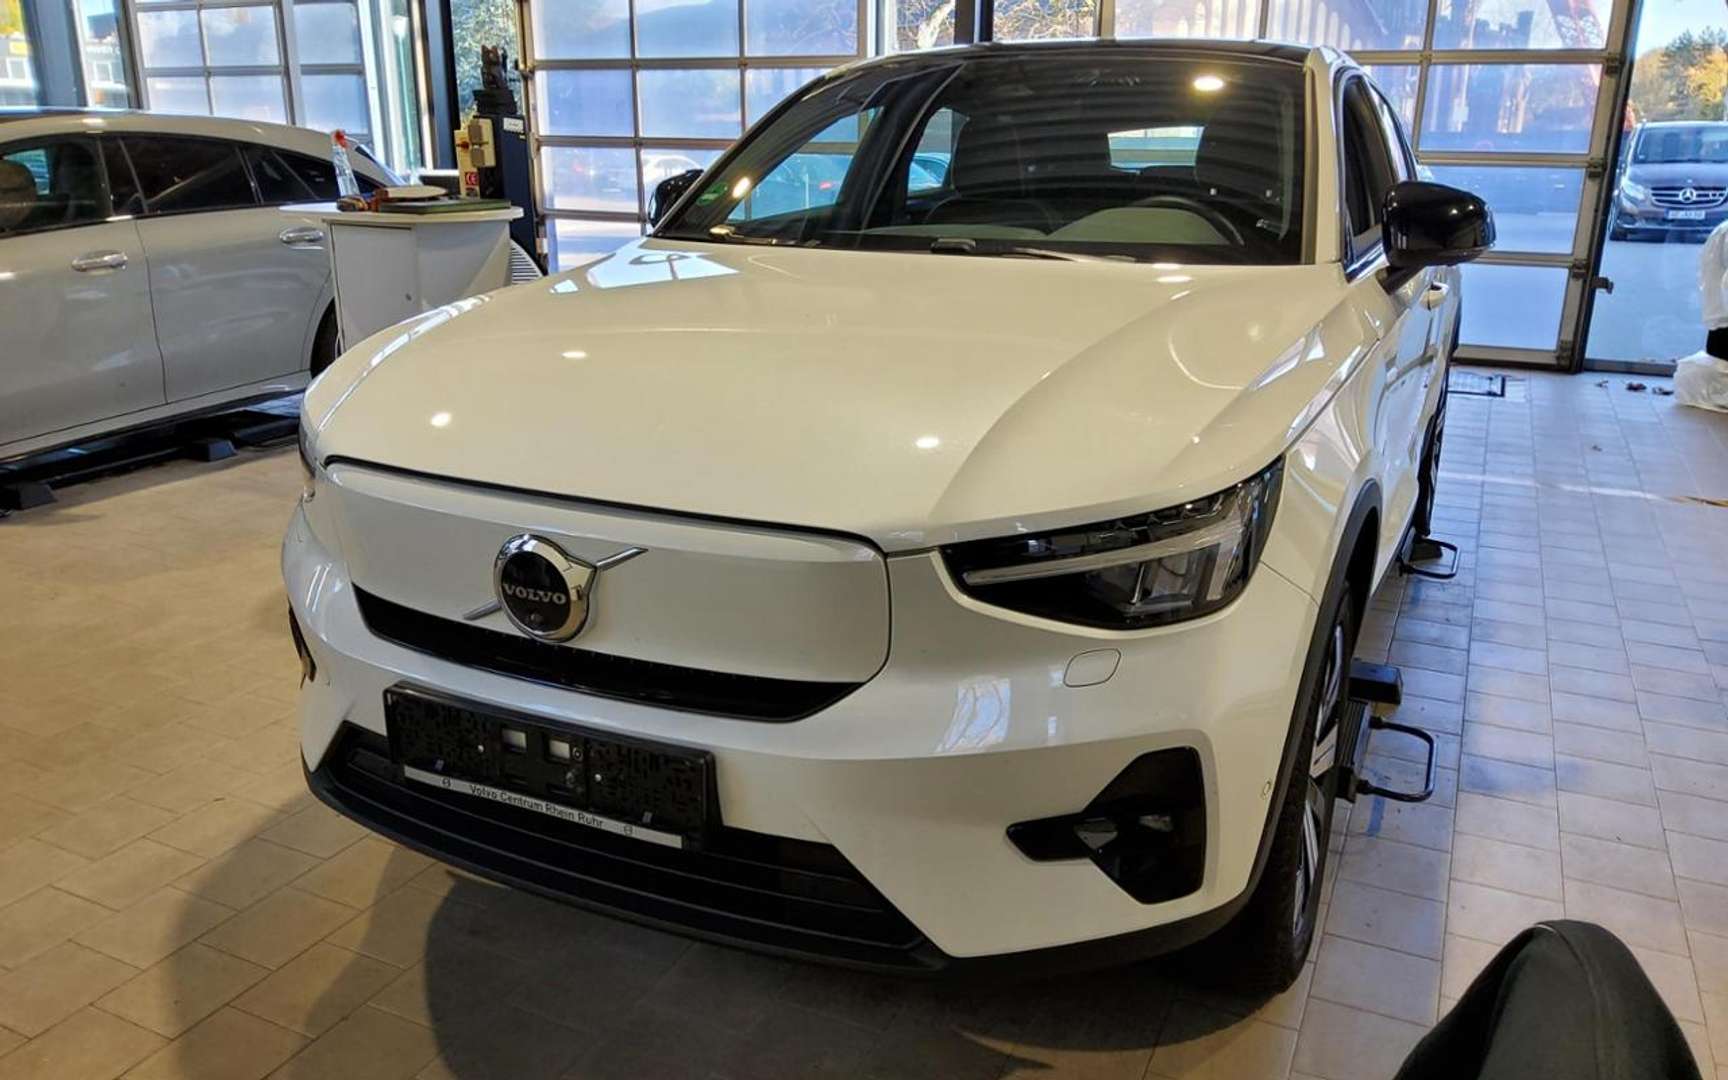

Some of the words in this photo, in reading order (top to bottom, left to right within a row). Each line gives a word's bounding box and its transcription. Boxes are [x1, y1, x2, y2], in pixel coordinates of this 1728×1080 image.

[503, 583, 567, 605] VOLVO
[471, 785, 498, 799] Volvo
[501, 791, 544, 811] Centrum
[545, 802, 575, 820] Rhein
[578, 811, 604, 827] Ruhr
